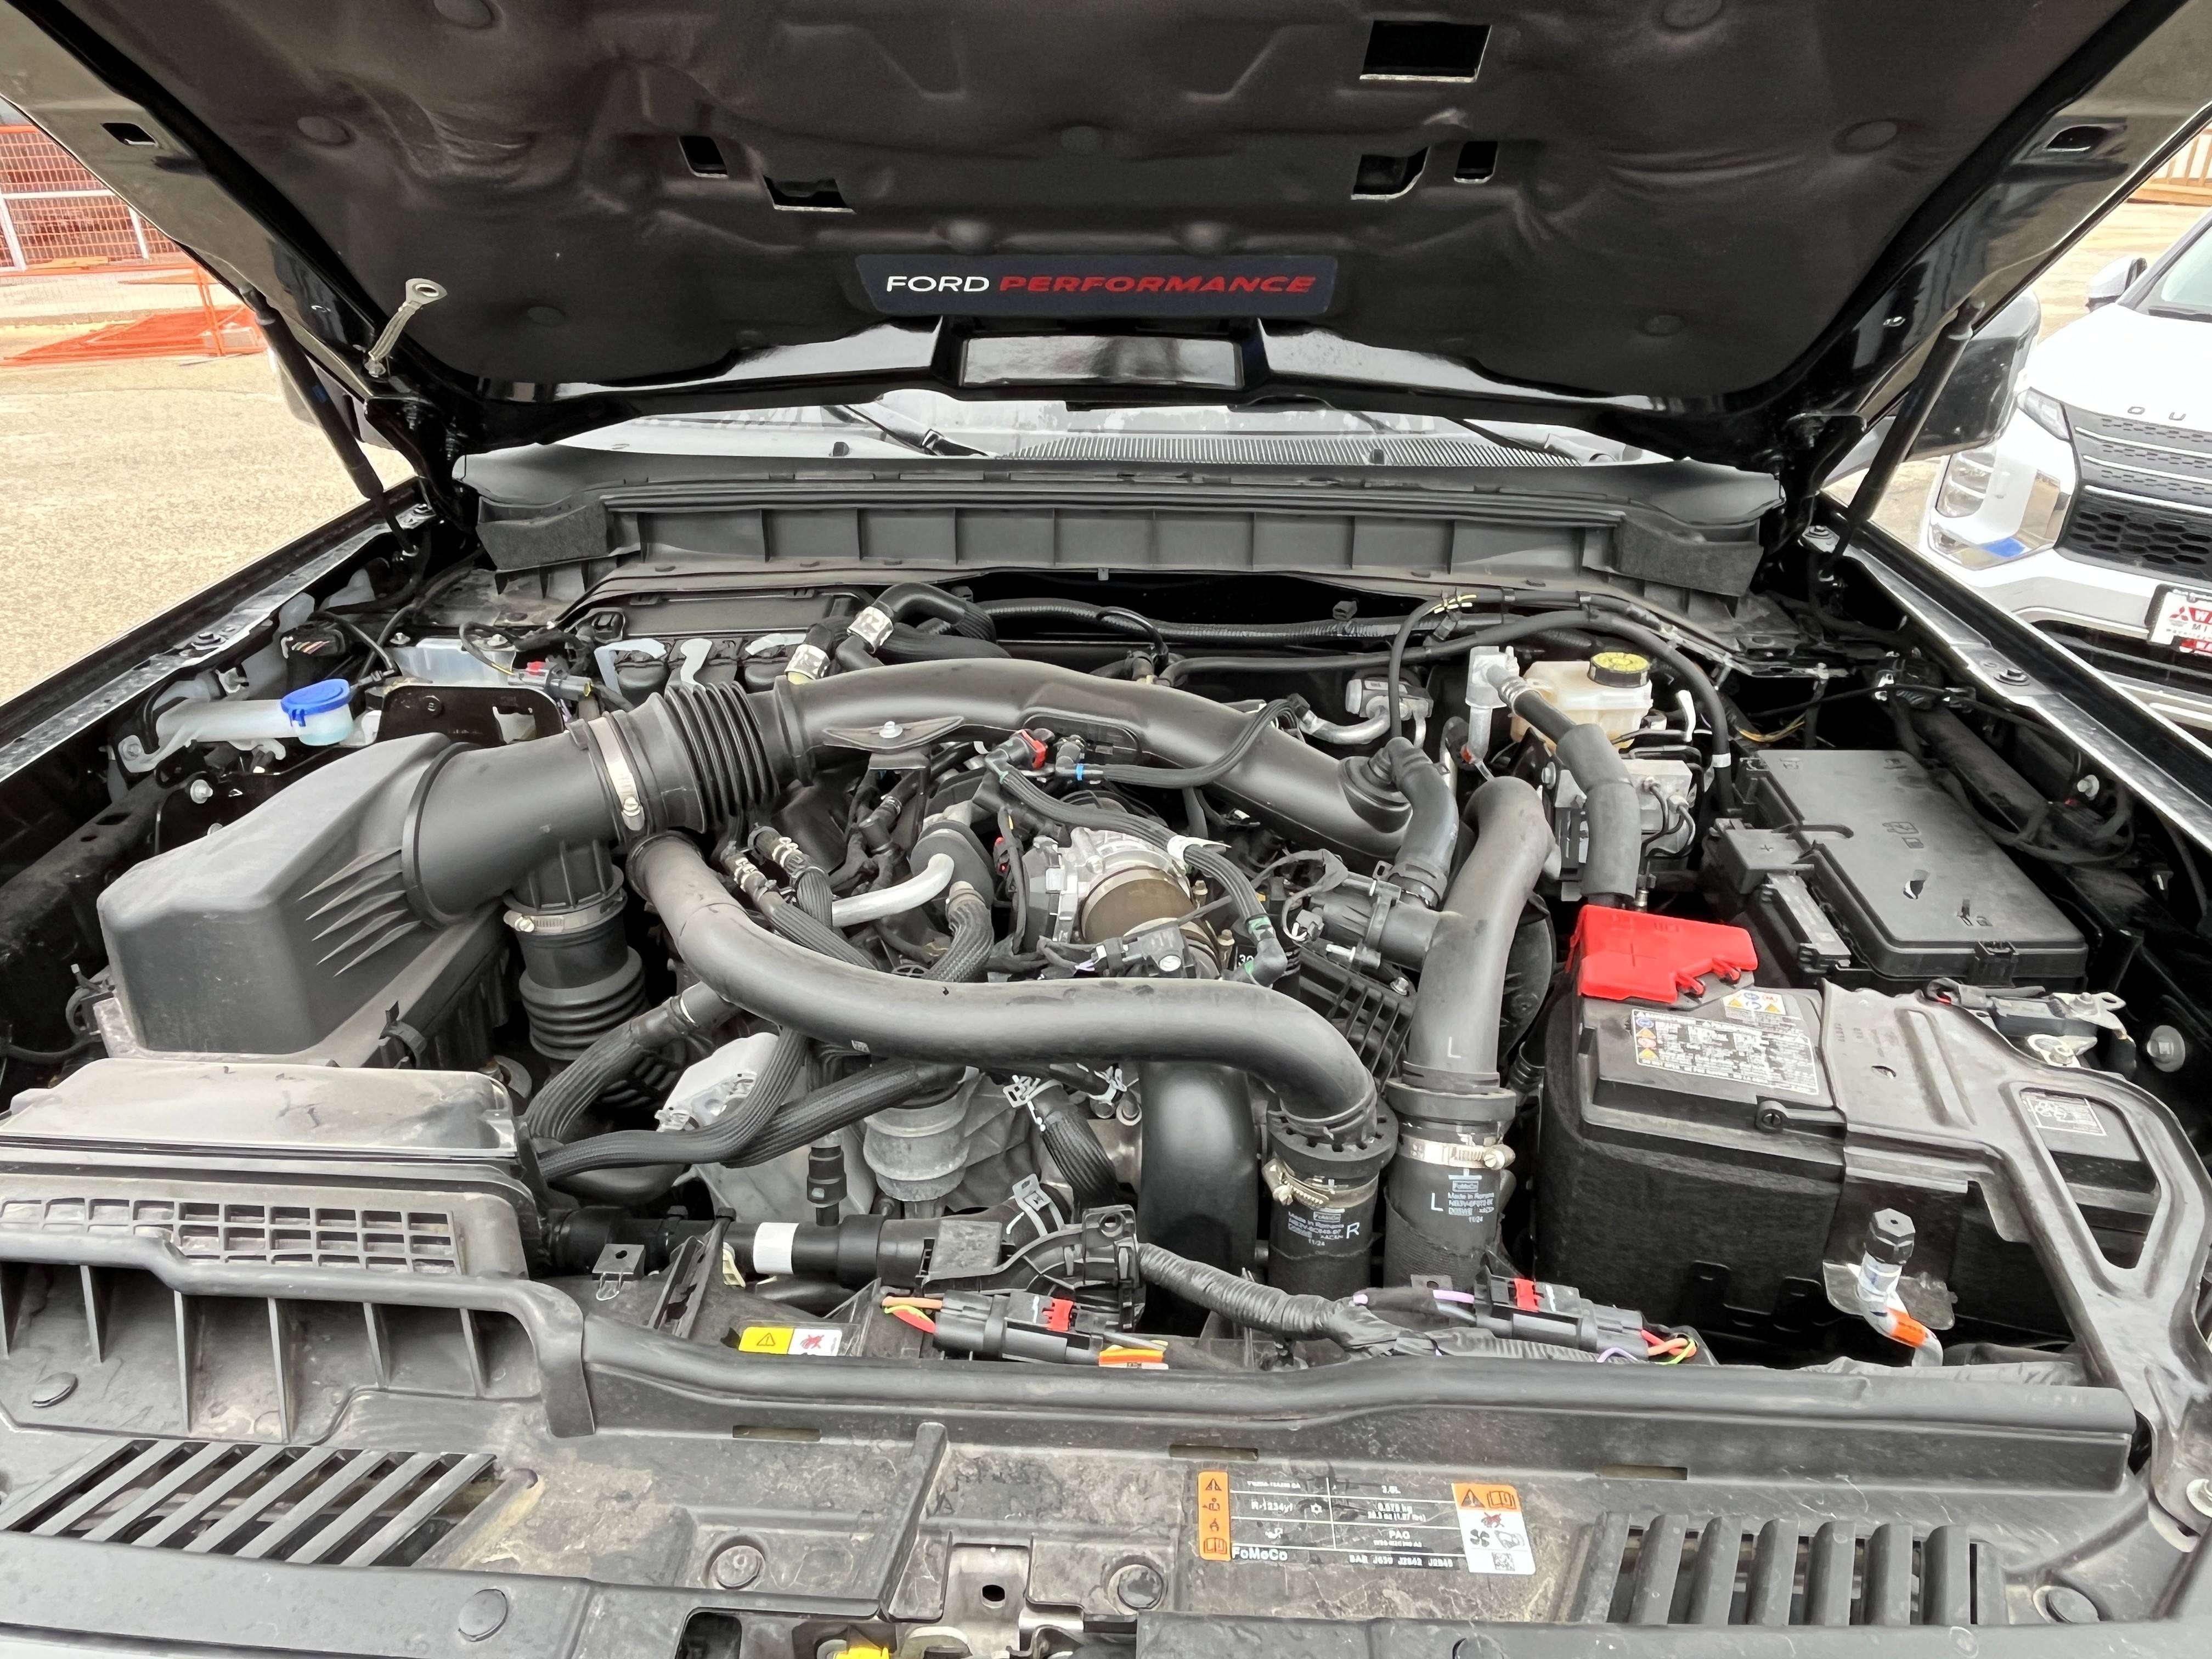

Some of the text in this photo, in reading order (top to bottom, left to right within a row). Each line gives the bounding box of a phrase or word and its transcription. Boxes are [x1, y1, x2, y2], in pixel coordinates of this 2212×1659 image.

[886, 276, 1316, 293] FORD PERFORMANCE
[1448, 1036, 1462, 1058] L
[1431, 1192, 1444, 1211] L
[1346, 1222, 1360, 1239] R
[1232, 1547, 1288, 1561] FoMoCo
